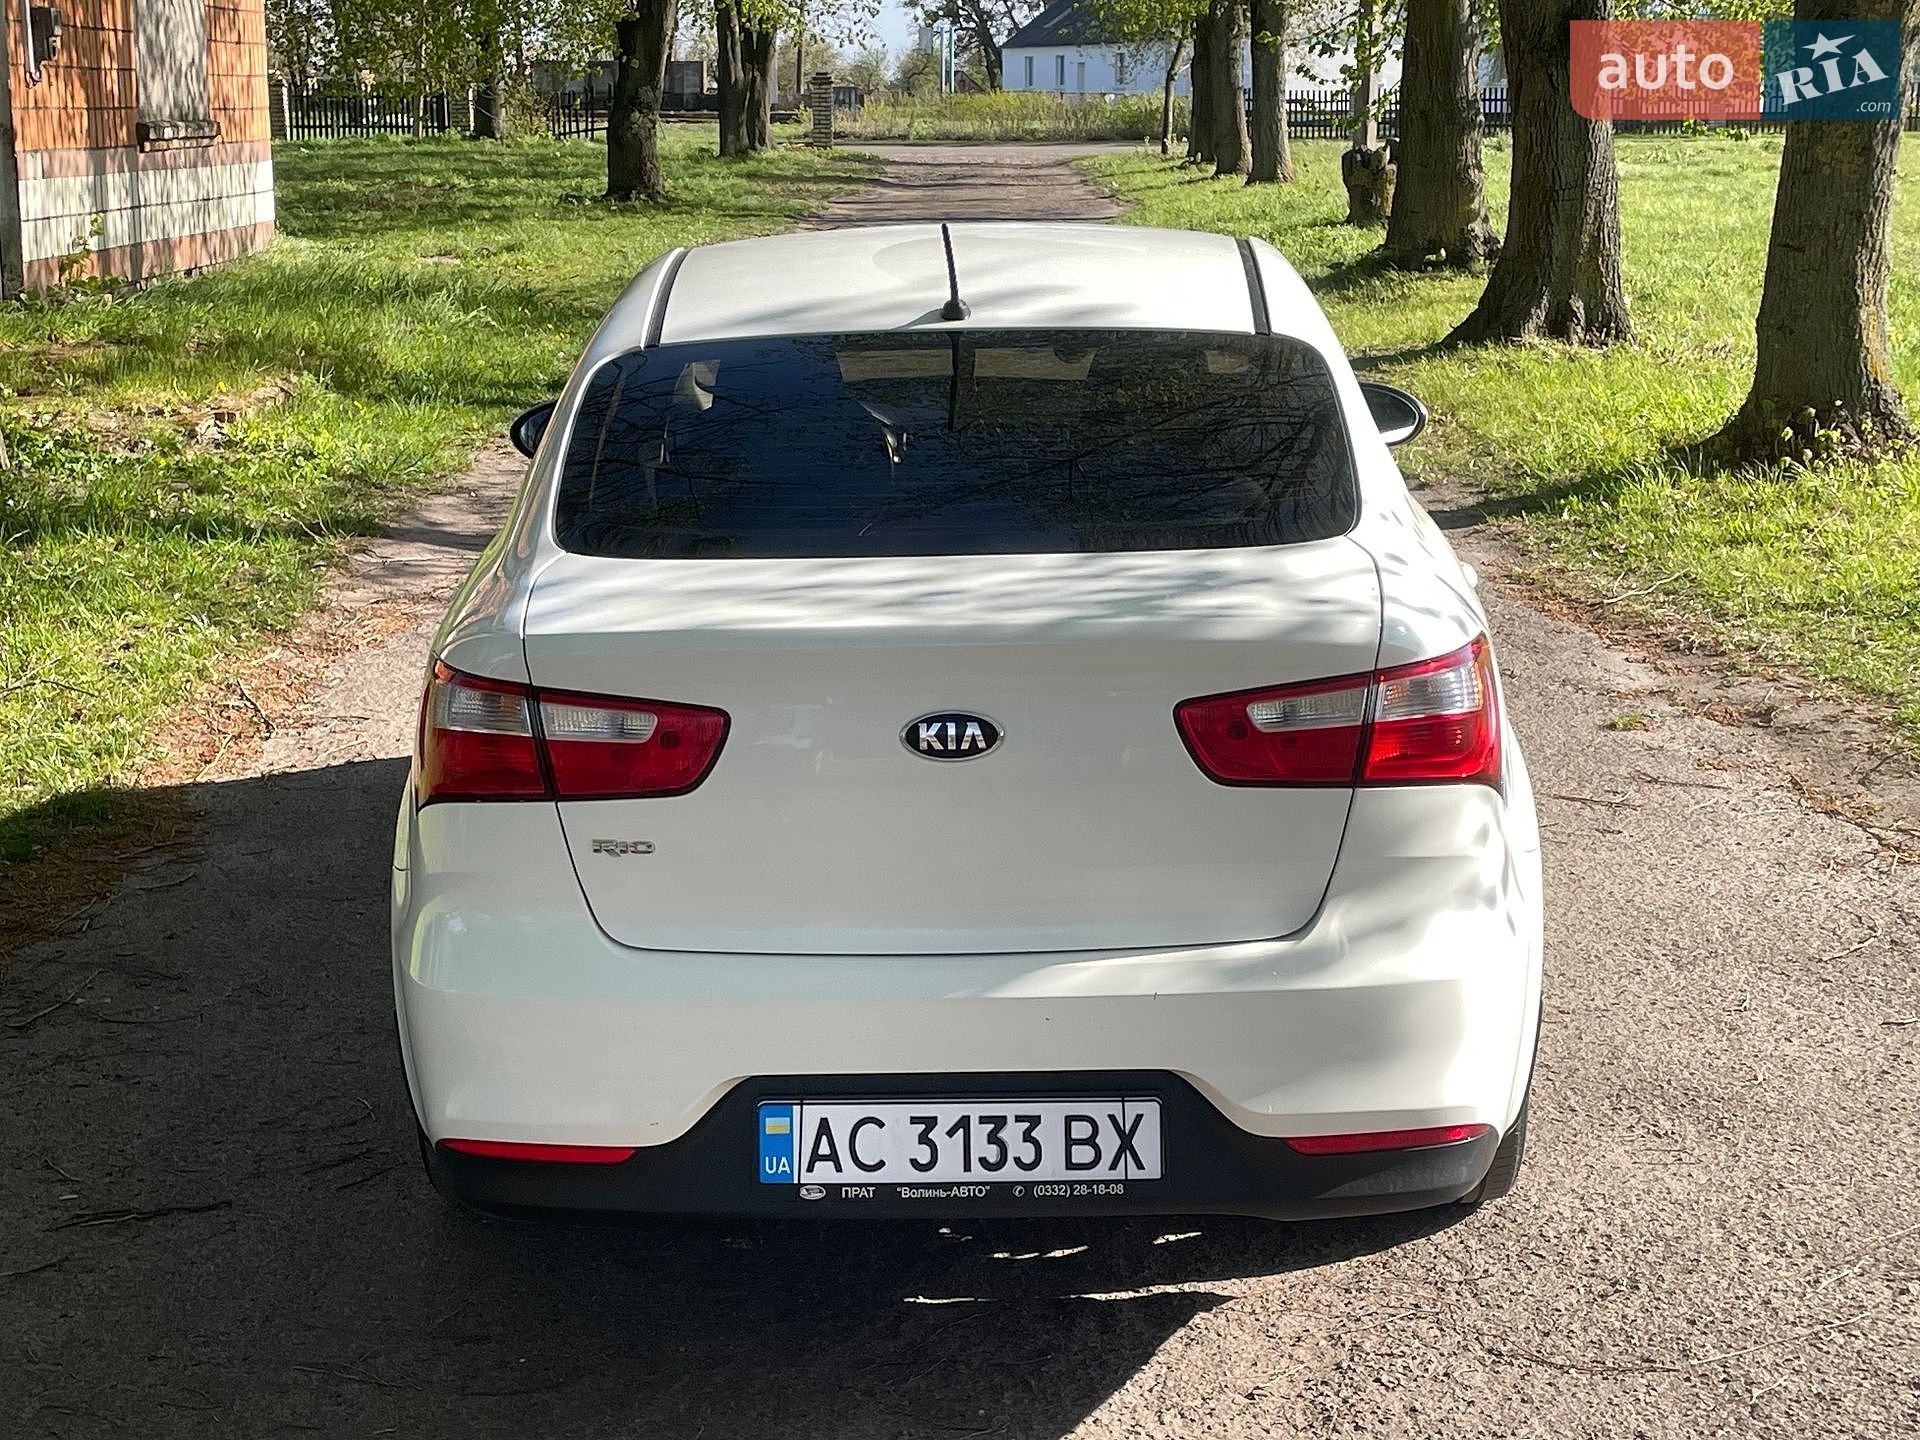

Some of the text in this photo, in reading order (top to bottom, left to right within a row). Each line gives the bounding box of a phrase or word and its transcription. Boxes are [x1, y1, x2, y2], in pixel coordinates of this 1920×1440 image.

[917, 721, 987, 751] KIA
[591, 838, 656, 857] RIO
[806, 1113, 1146, 1173] AC 3133 BX
[765, 1156, 791, 1174] UA
[841, 1183, 1125, 1199] ПРАТ "Волинь-АВТО" (0332) 28-18-08
